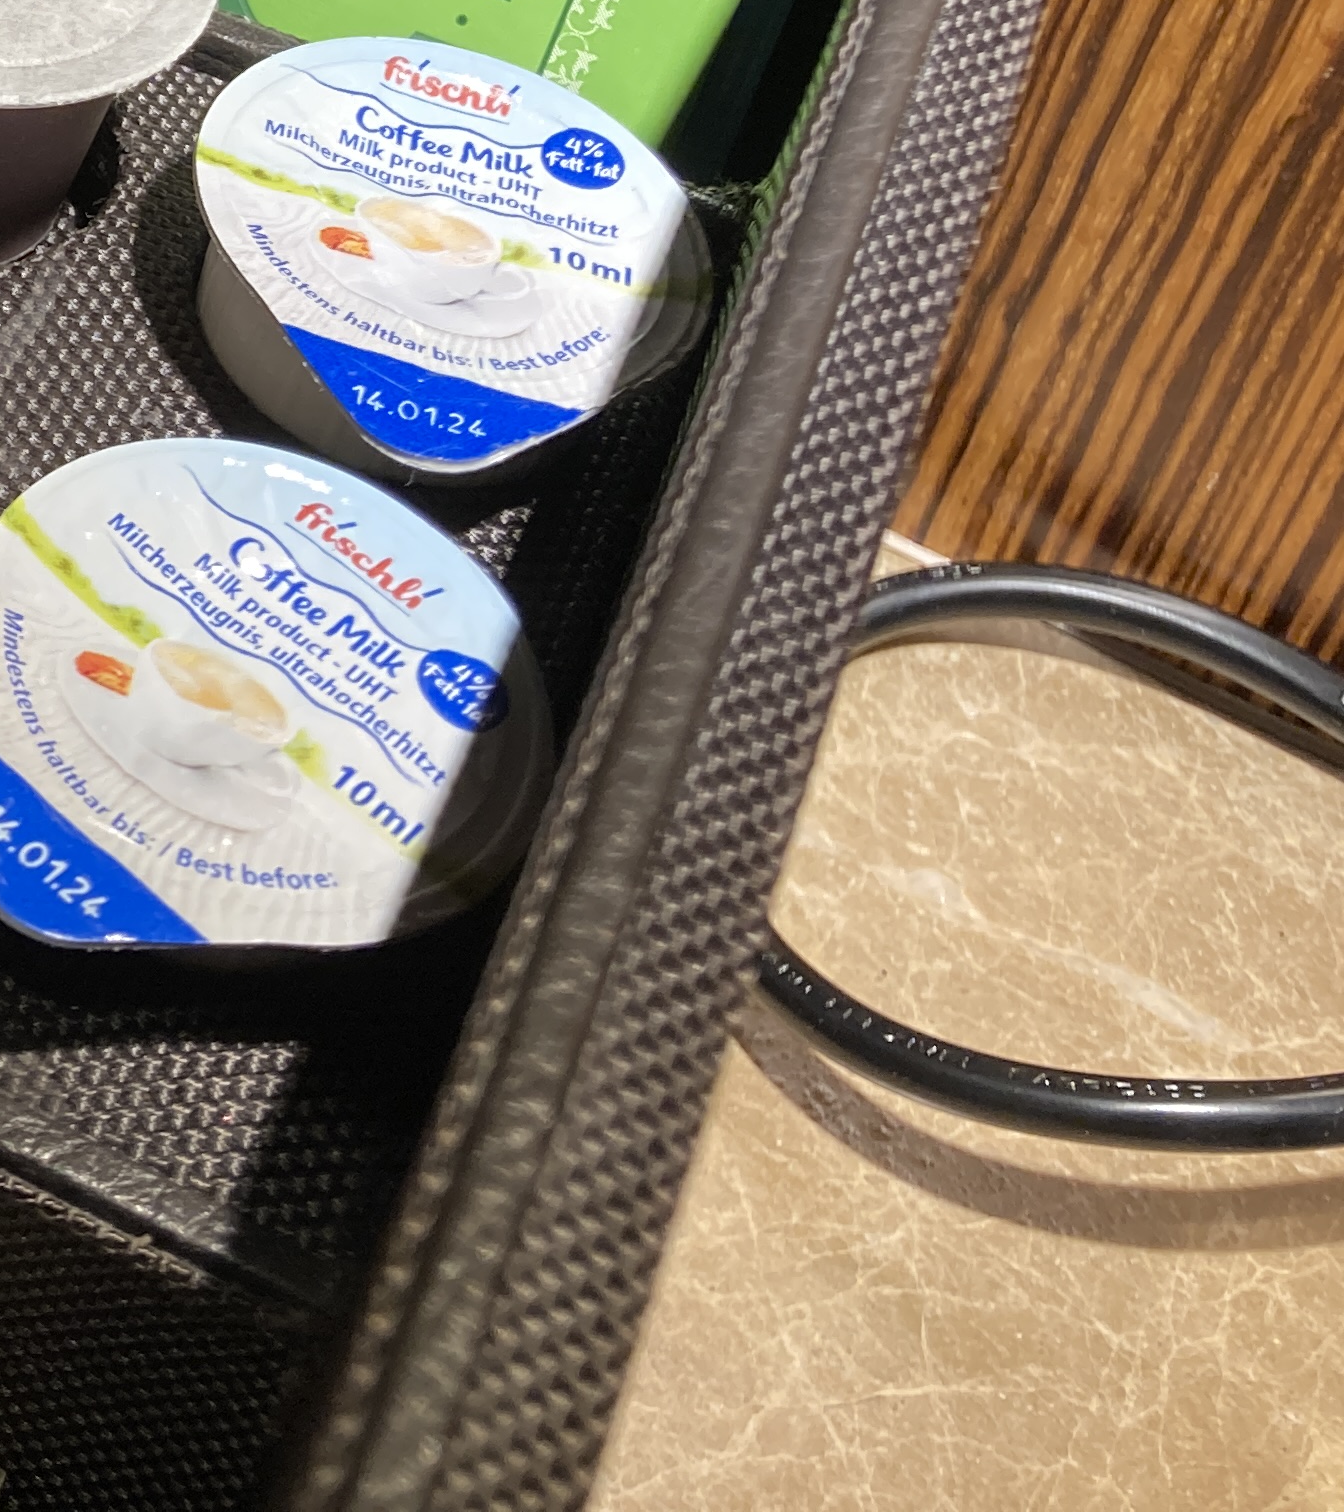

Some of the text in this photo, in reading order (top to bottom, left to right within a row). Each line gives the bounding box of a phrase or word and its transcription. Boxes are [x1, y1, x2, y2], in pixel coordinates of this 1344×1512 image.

[265, 119, 619, 238] Milcherzeugnis, ultrahocherhitzt
[338, 129, 383, 159] Milk
[390, 152, 477, 186] product
[498, 177, 543, 201] UHT
[356, 105, 534, 179] Coffee Milk
[564, 138, 605, 158] 4%
[247, 224, 341, 315] Mindestens
[344, 311, 426, 354] haltbar
[489, 356, 542, 371] Best
[352, 385, 486, 437] 14.01.24
[107, 512, 446, 786] Milcherzeugnis, ultrahocherhitzt
[237, 597, 334, 661] product
[344, 663, 399, 703] UHT
[324, 615, 406, 678] Milk
[3, 608, 45, 735] Mindestens
[37, 740, 111, 815] haltbar
[175, 847, 235, 882] Best
